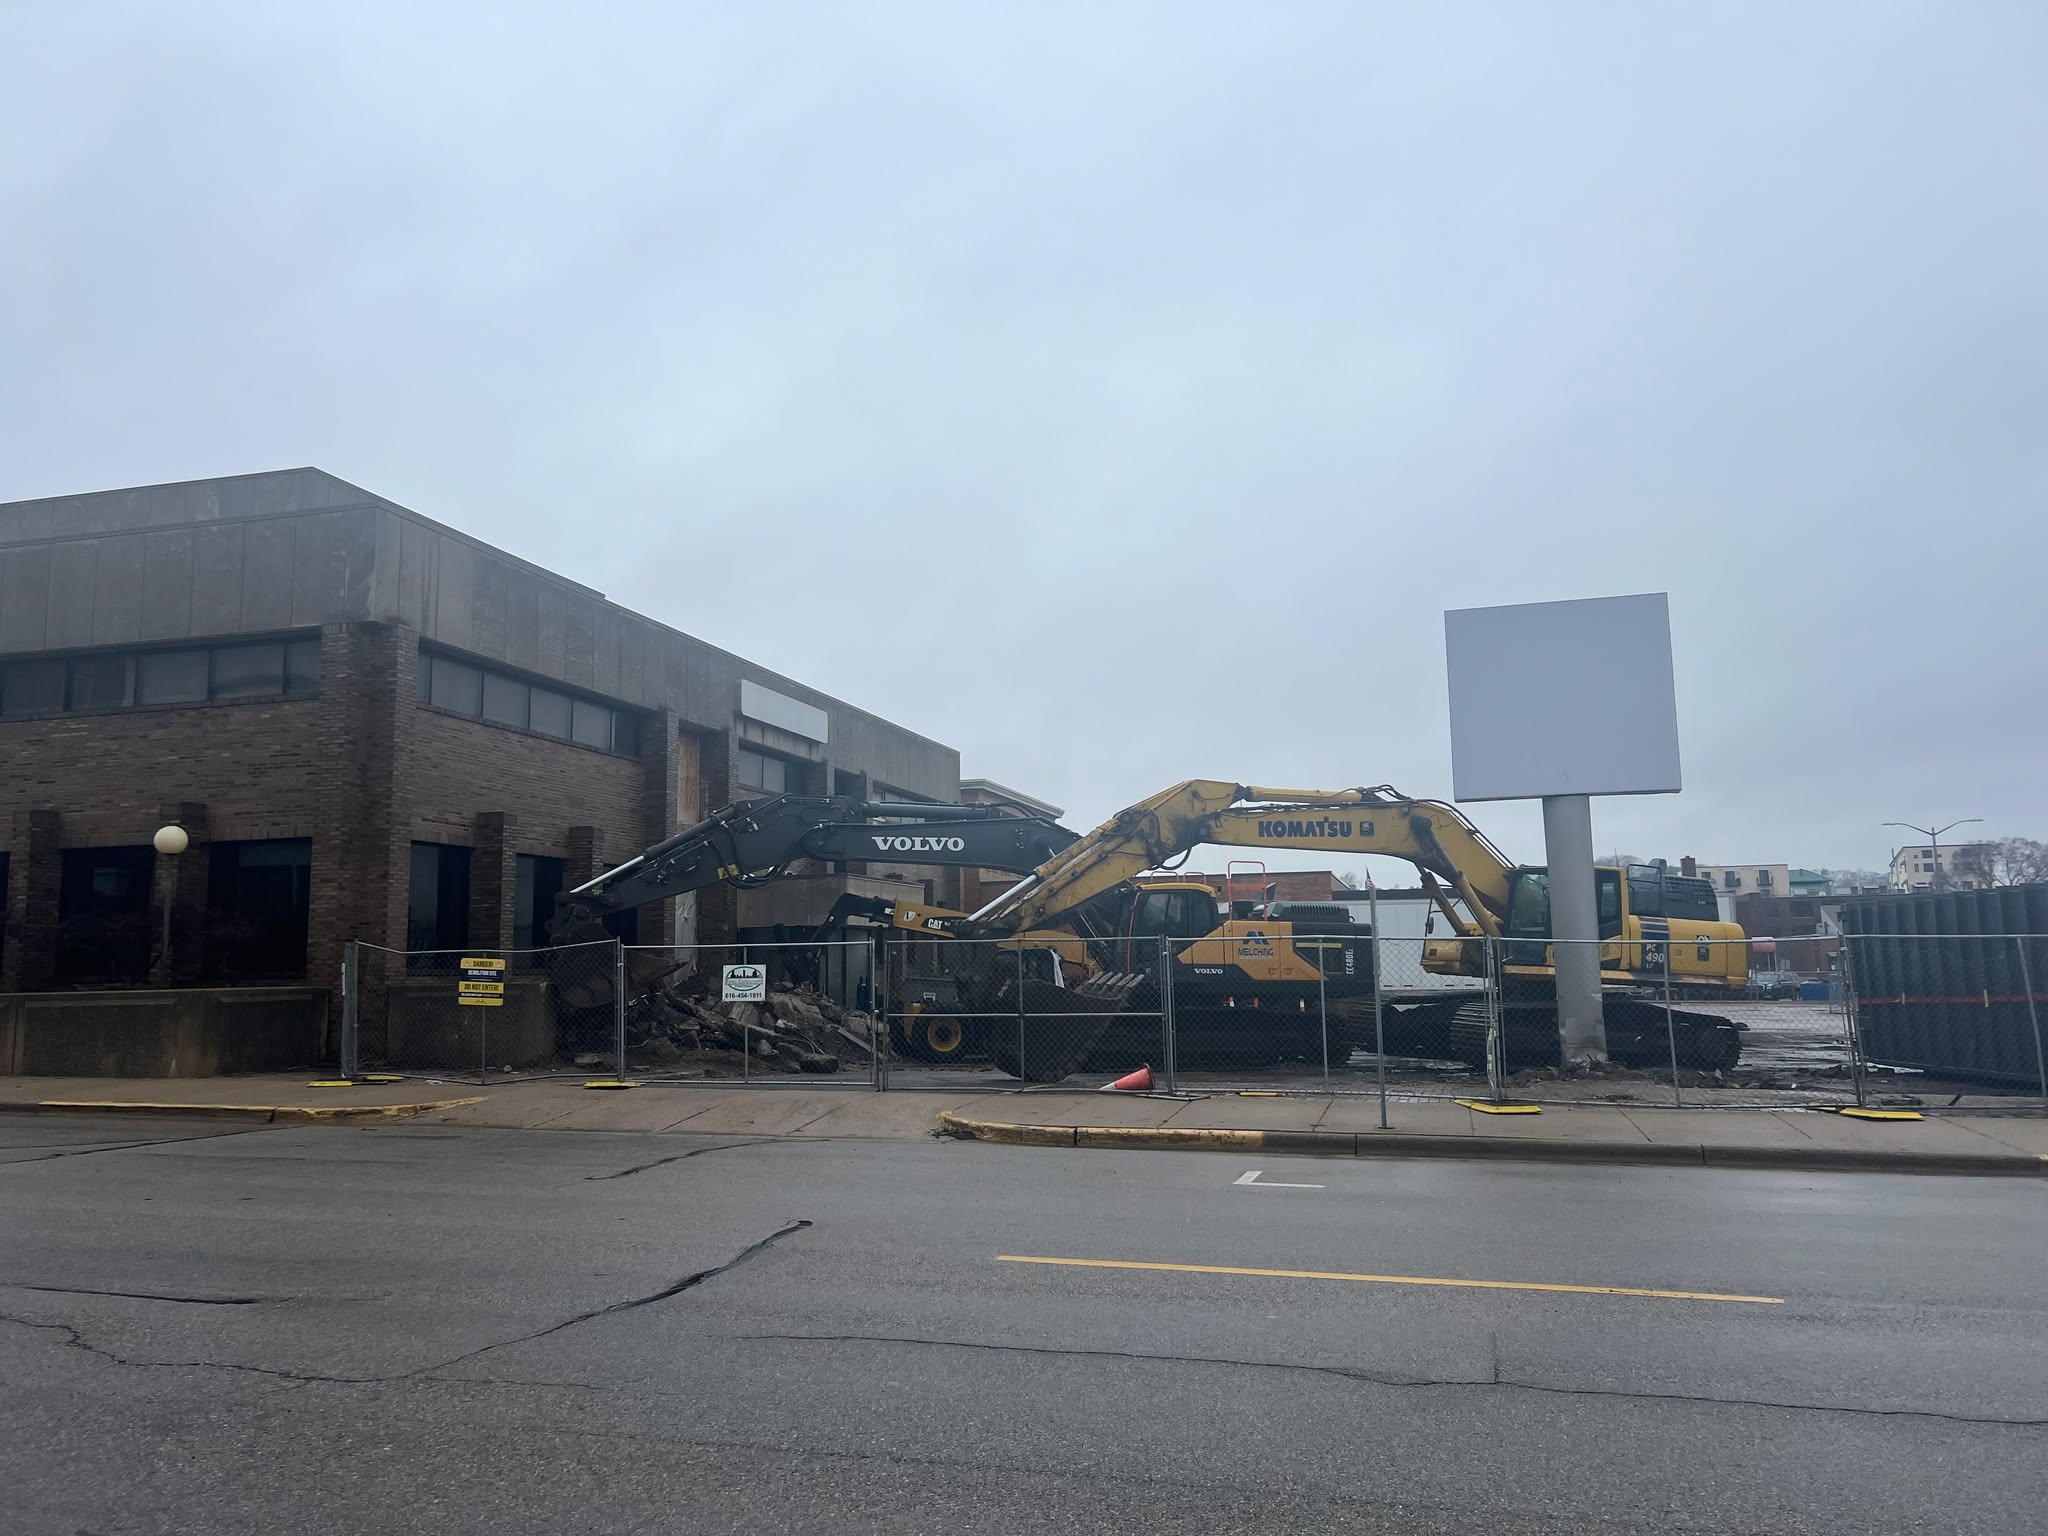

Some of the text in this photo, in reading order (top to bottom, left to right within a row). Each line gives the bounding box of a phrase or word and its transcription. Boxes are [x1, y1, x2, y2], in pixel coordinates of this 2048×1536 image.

[1258, 816, 1352, 838] KOMATSU
[871, 836, 965, 852] VOLVO
[928, 918, 943, 930] CAT
[1237, 947, 1274, 957] MELCHING
[1646, 943, 1656, 951] PC
[1646, 952, 1664, 963] 490
[473, 960, 493, 968] DANGER!
